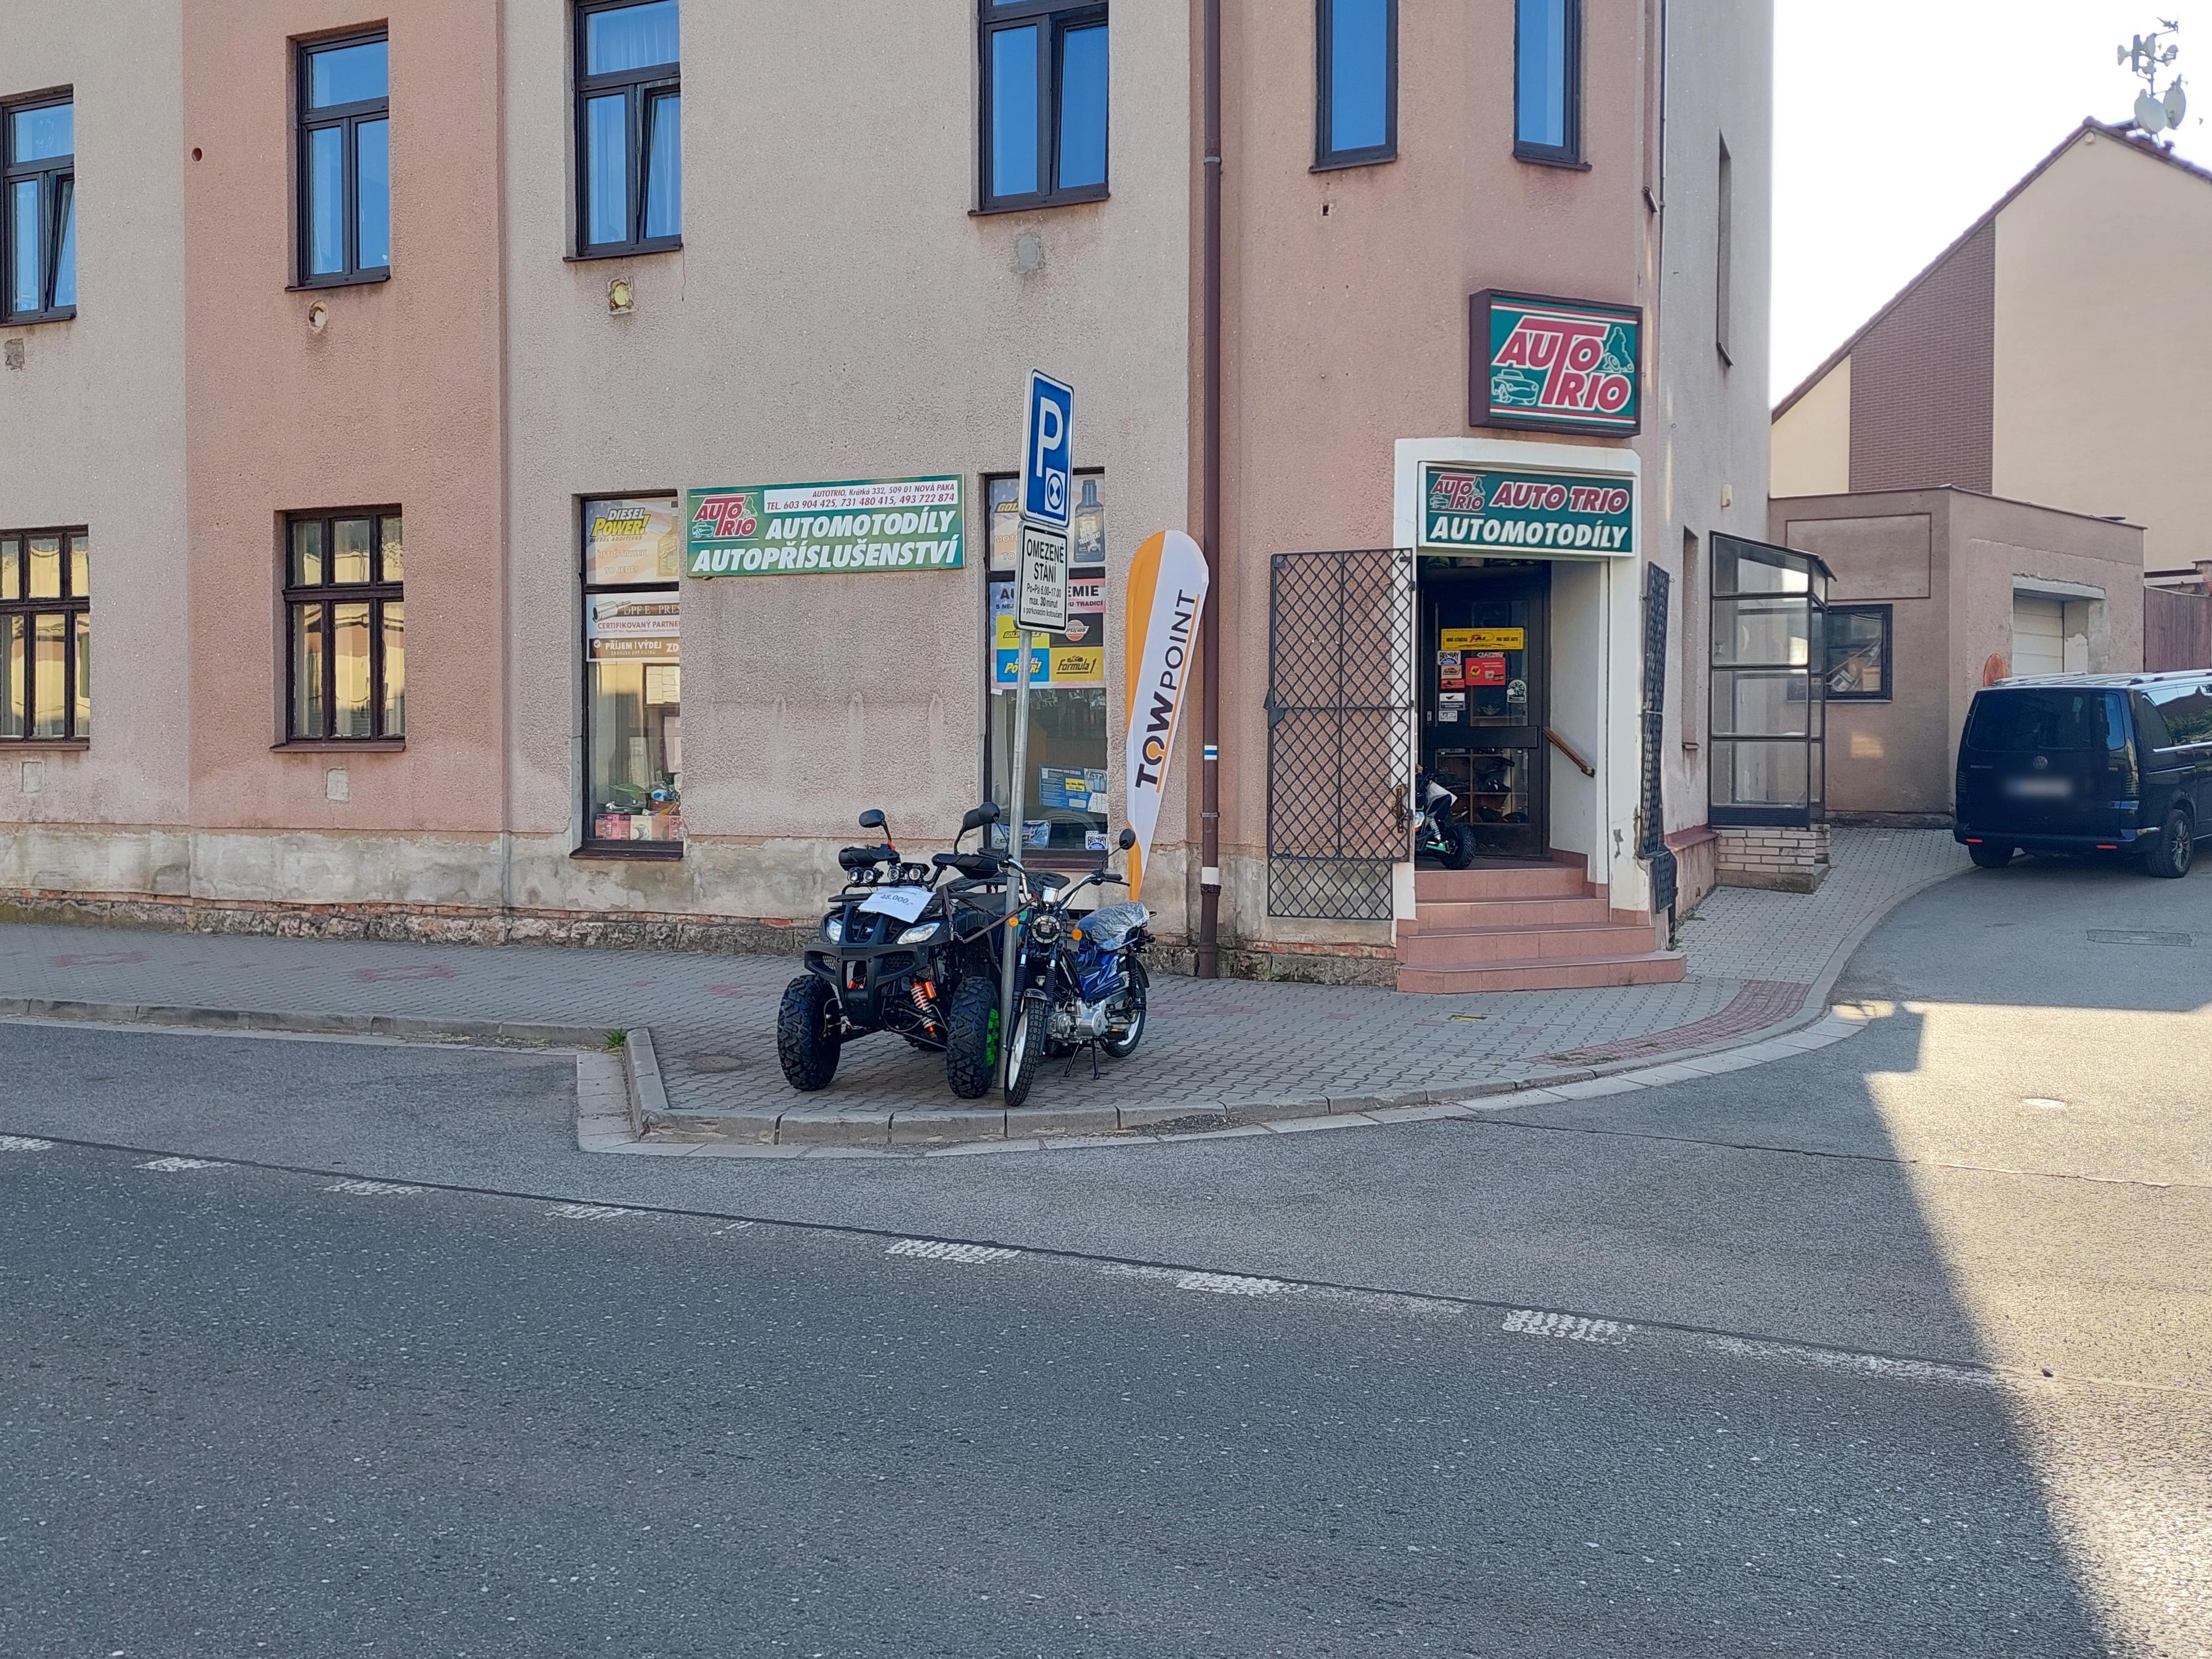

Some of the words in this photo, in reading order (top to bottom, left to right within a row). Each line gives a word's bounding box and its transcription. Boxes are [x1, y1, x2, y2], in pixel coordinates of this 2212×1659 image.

[1036, 396, 1063, 478] P
[784, 501, 799, 509] 603
[802, 500, 817, 508] 904
[820, 499, 838, 508] 425,
[841, 498, 856, 507] 731
[859, 497, 875, 506] 480
[878, 496, 896, 505] 415,
[899, 495, 916, 504] 493
[919, 494, 936, 503] 722
[938, 493, 954, 502] 874
[812, 489, 847, 498] AUTOTRIO,
[1489, 481, 1567, 510] AUTO
[1568, 486, 1630, 514] TRIO
[608, 508, 645, 520] DIESEL
[997, 503, 1018, 512] GOL
[590, 514, 651, 537] POWER!
[765, 507, 957, 540] AUTOMOTODÍLY
[1430, 516, 1628, 548] AUTOMOTODÍLY
[691, 534, 960, 572] AUTOPŘÍSLUŠENSTVÍ
[1027, 538, 1064, 564] OMEZENÉ
[1034, 561, 1056, 583] STÁNÍ
[1029, 597, 1039, 606] max.
[1040, 597, 1046, 606] 30
[598, 619, 651, 629] CERTIFIKOVANÝ
[605, 640, 632, 650] PŘÍJEM
[638, 639, 662, 649] VÝDEJ
[1057, 658, 1089, 671] Formula
